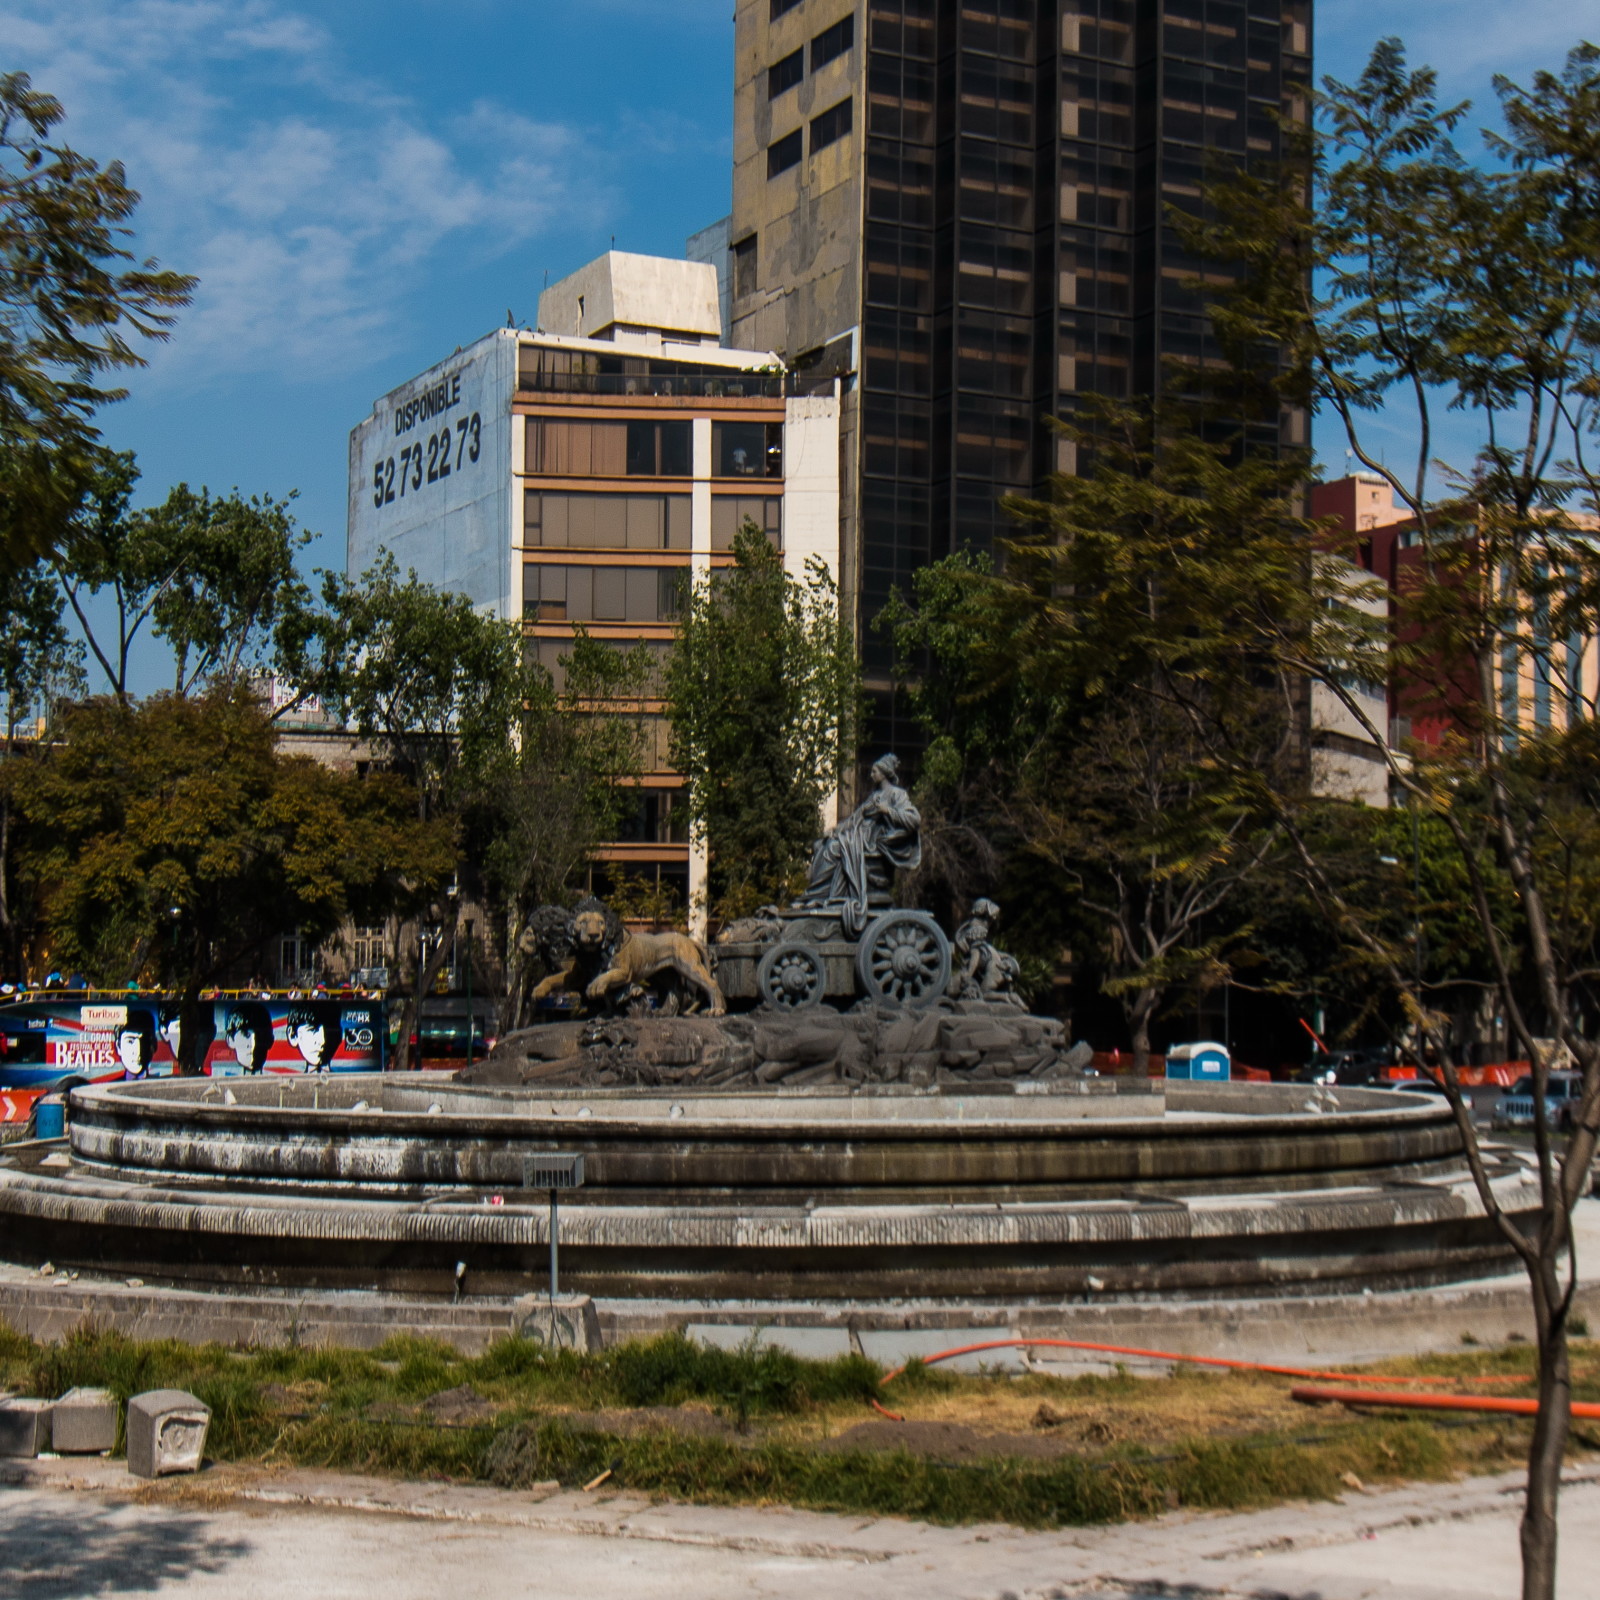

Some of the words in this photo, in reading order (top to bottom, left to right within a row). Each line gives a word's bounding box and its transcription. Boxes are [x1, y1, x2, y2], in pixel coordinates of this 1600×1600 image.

[395, 375, 461, 437] DISPONIBLE
[374, 456, 395, 509] 52
[400, 442, 423, 497] 73
[427, 427, 451, 485] 22
[457, 412, 482, 472] 73
[86, 1009, 120, 1019] Turibus
[80, 1032, 88, 1042] EL
[91, 1032, 112, 1043] GRAN
[55, 1041, 115, 1072] BEATLES
